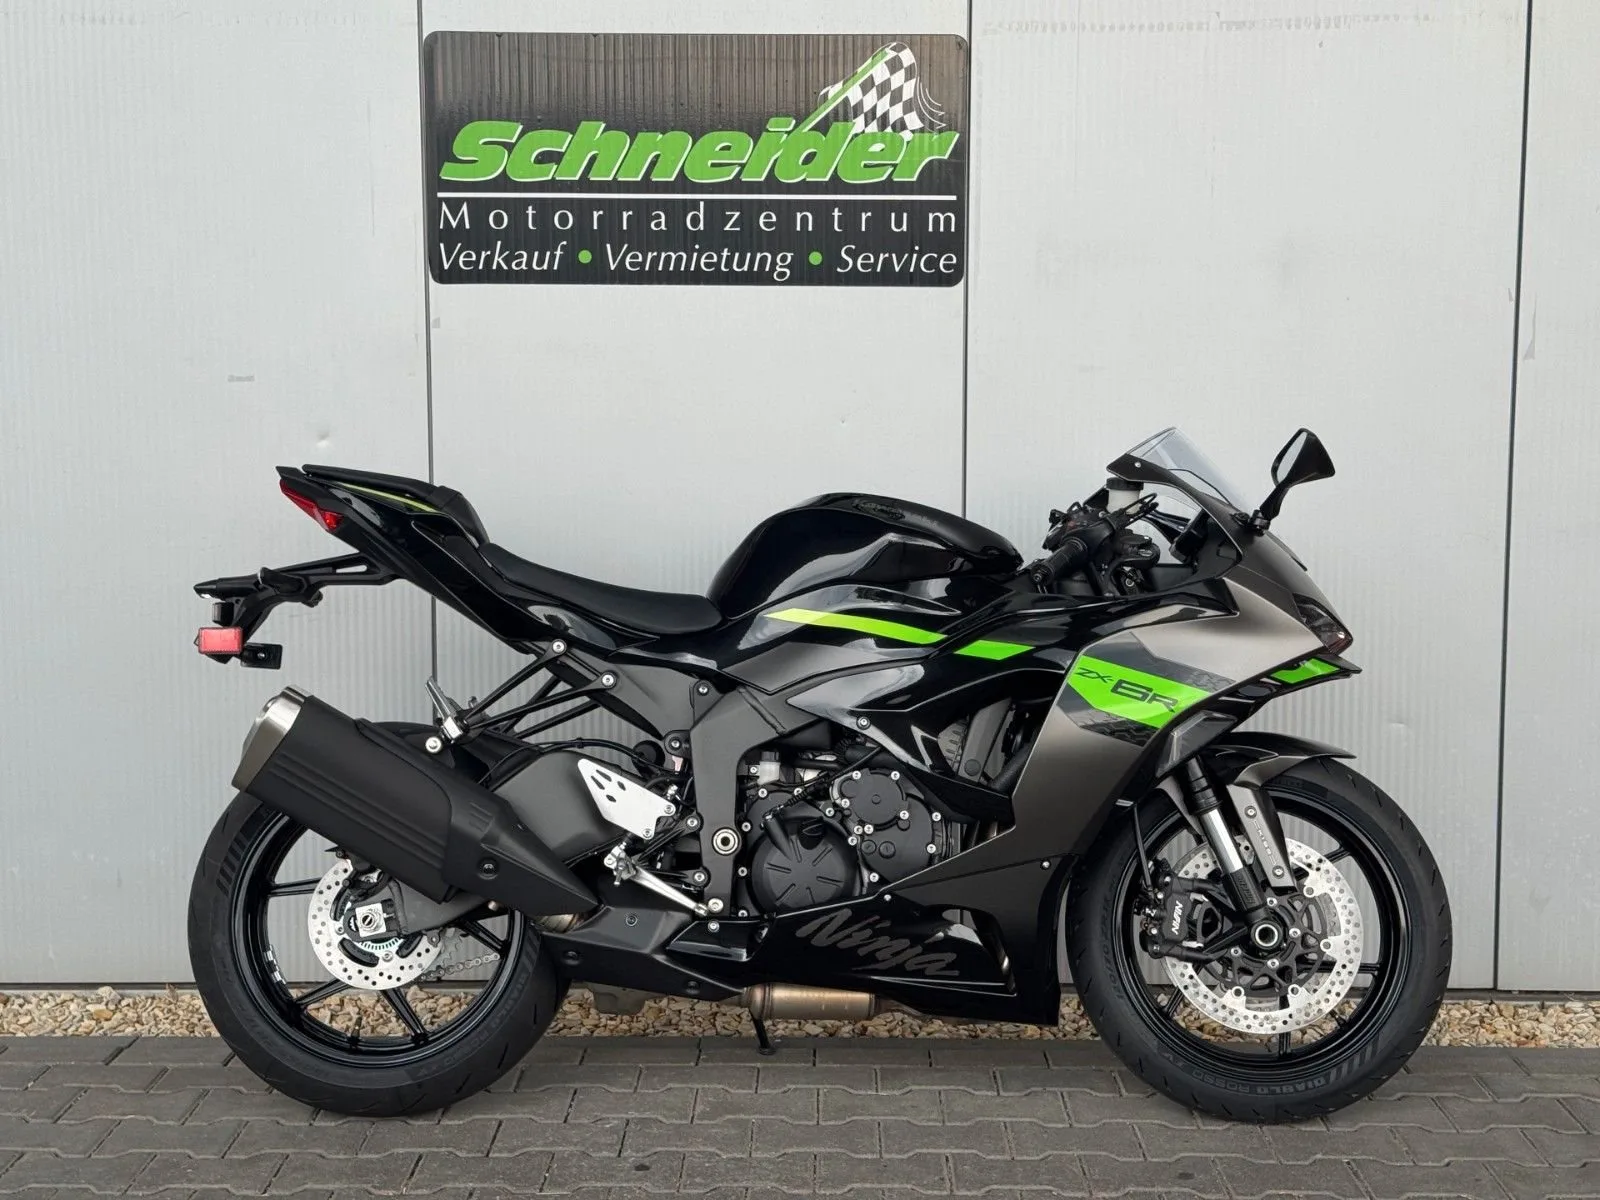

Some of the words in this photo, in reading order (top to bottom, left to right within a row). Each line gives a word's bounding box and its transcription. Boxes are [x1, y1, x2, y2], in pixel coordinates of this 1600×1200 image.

[439, 117, 959, 183] Schneider
[439, 201, 957, 232] Motorradzentrum
[439, 241, 568, 272] Verkauf
[605, 242, 794, 281] Vermietung
[836, 245, 957, 275] Service
[796, 908, 960, 976] Ninja
[1256, 1075, 1326, 1095] DIABLO
